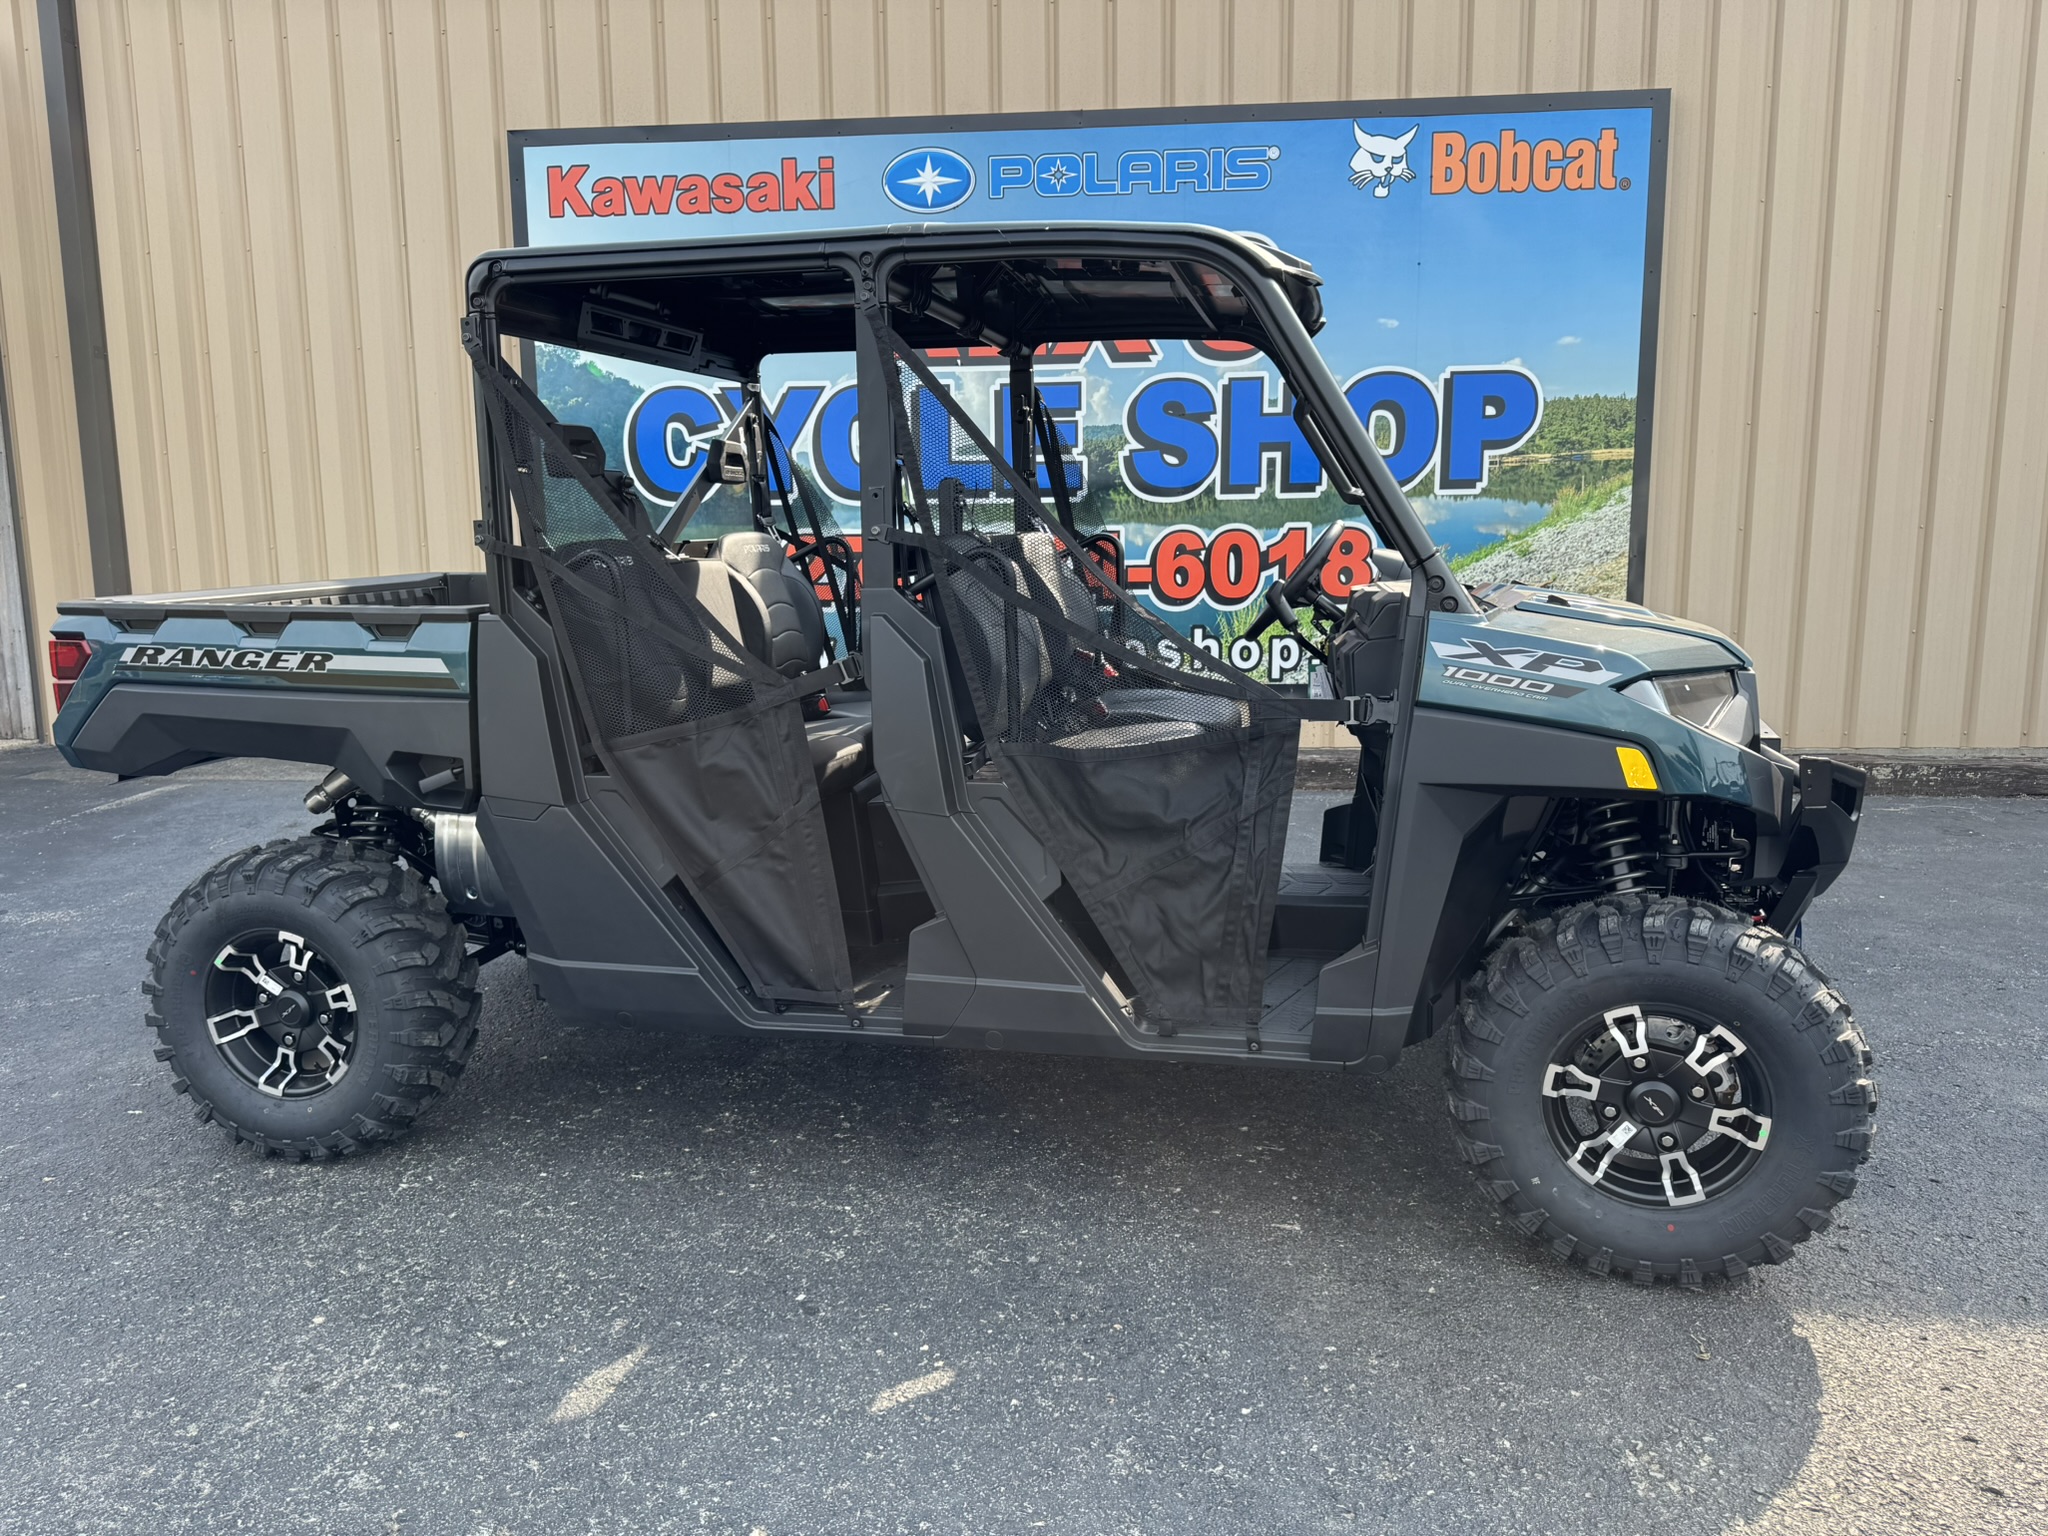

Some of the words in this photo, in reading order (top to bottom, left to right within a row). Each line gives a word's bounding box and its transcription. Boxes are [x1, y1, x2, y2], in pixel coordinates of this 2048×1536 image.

[988, 146, 1271, 200] POLARIS
[1430, 127, 1619, 195] Bobcat
[547, 157, 834, 219] Kawasaki
[1120, 366, 1544, 504] SHOP
[130, 645, 334, 673] RANGER
[1441, 637, 1606, 673] XP
[1442, 665, 1555, 694] 1000
[1442, 679, 1469, 688] DUAL
[1471, 683, 1524, 697] OVERHEAD
[1525, 692, 1549, 702] CAM
[1643, 1095, 1665, 1117] XP
